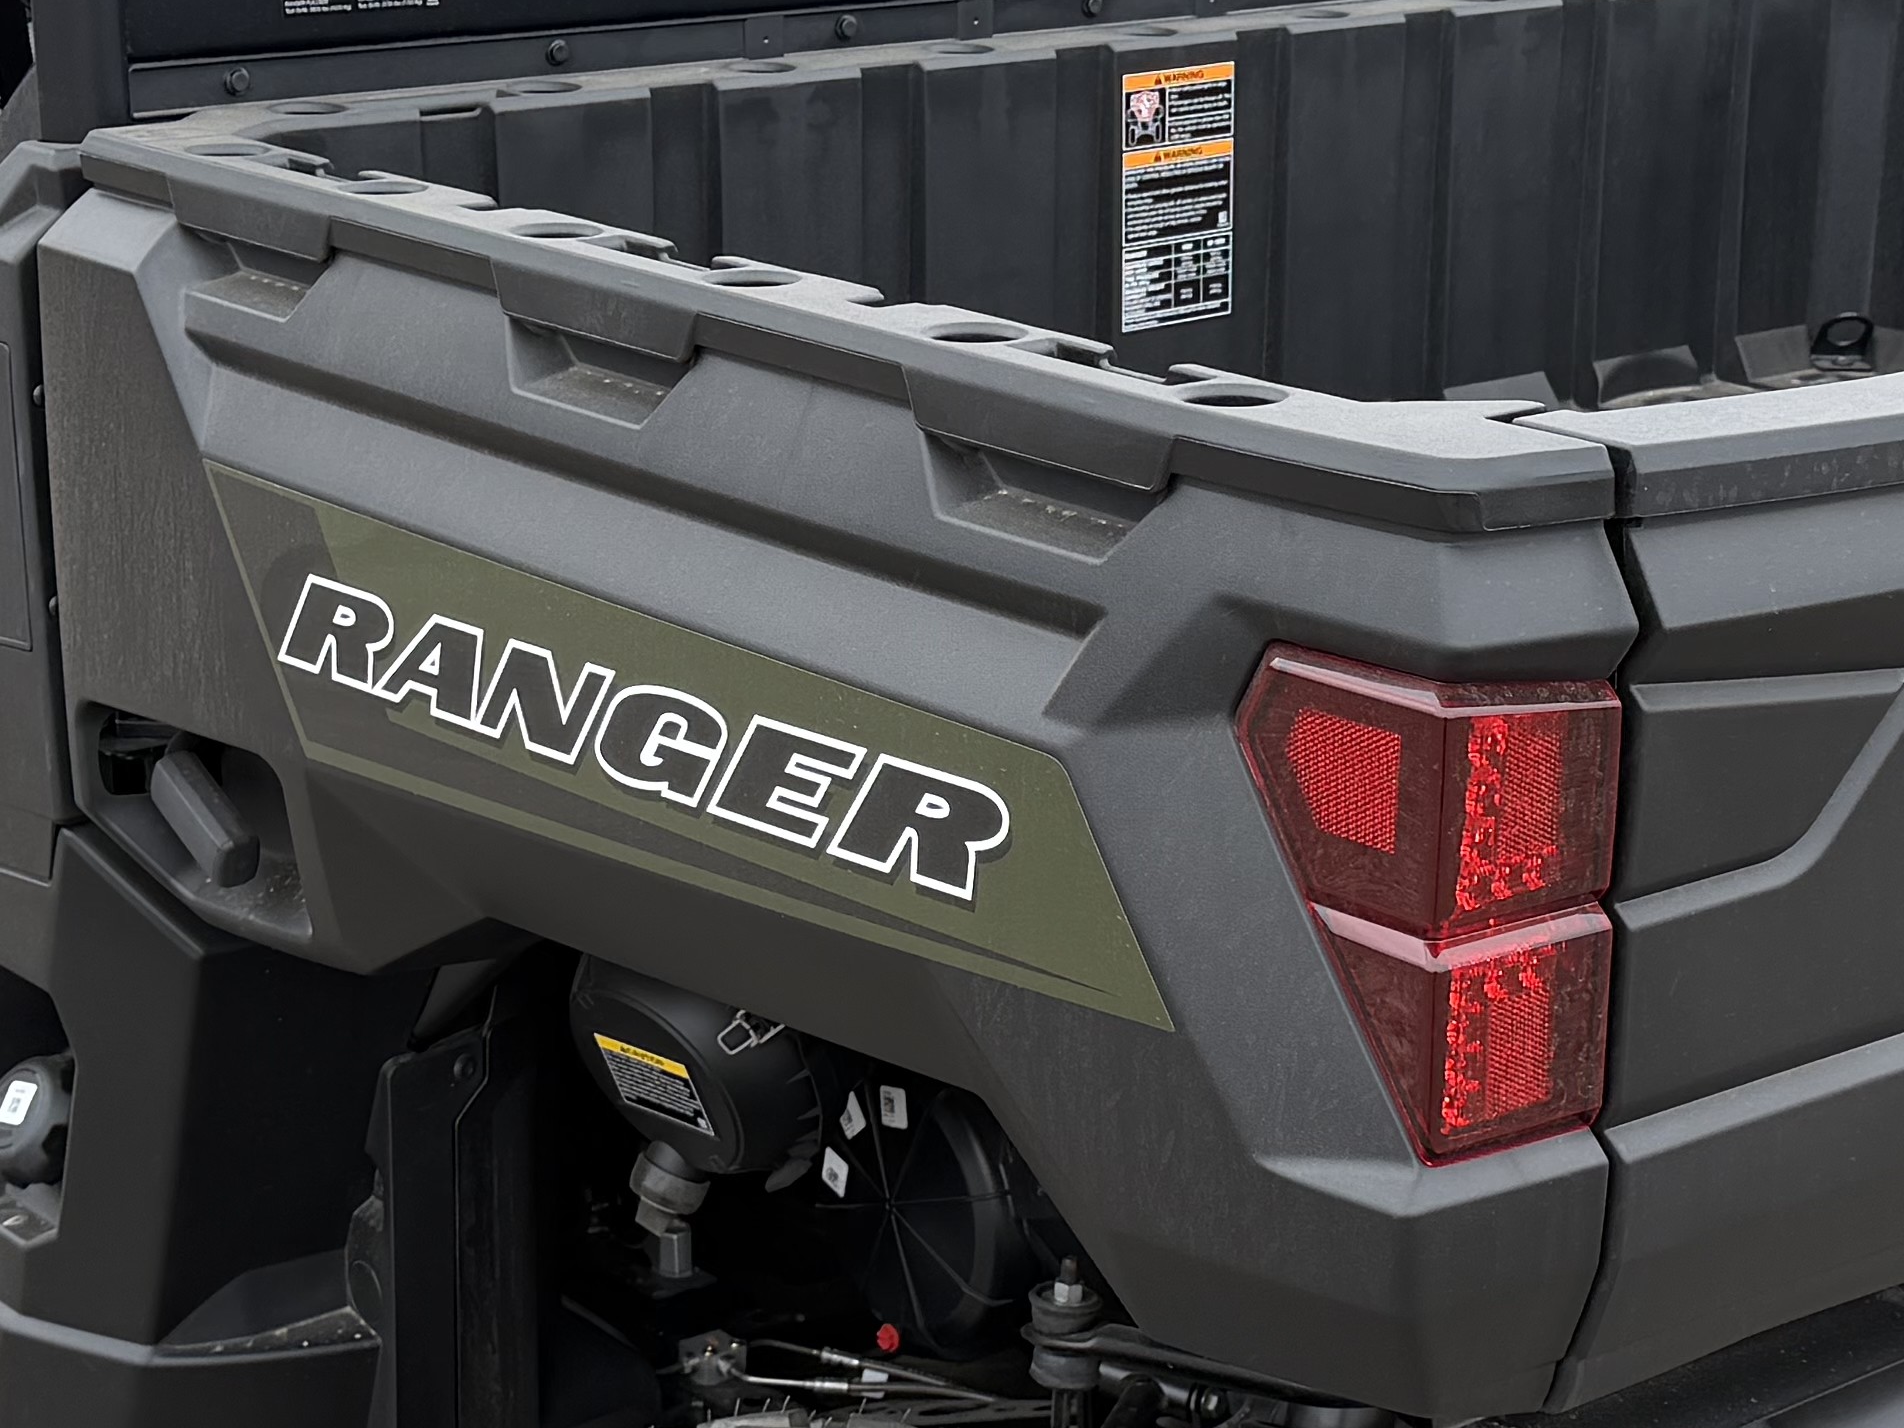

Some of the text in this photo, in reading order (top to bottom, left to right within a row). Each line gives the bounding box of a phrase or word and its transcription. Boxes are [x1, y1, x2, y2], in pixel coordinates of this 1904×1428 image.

[1164, 70, 1204, 81] WARNING
[1163, 147, 1203, 159] WARNING
[277, 574, 1012, 904] RANGER
